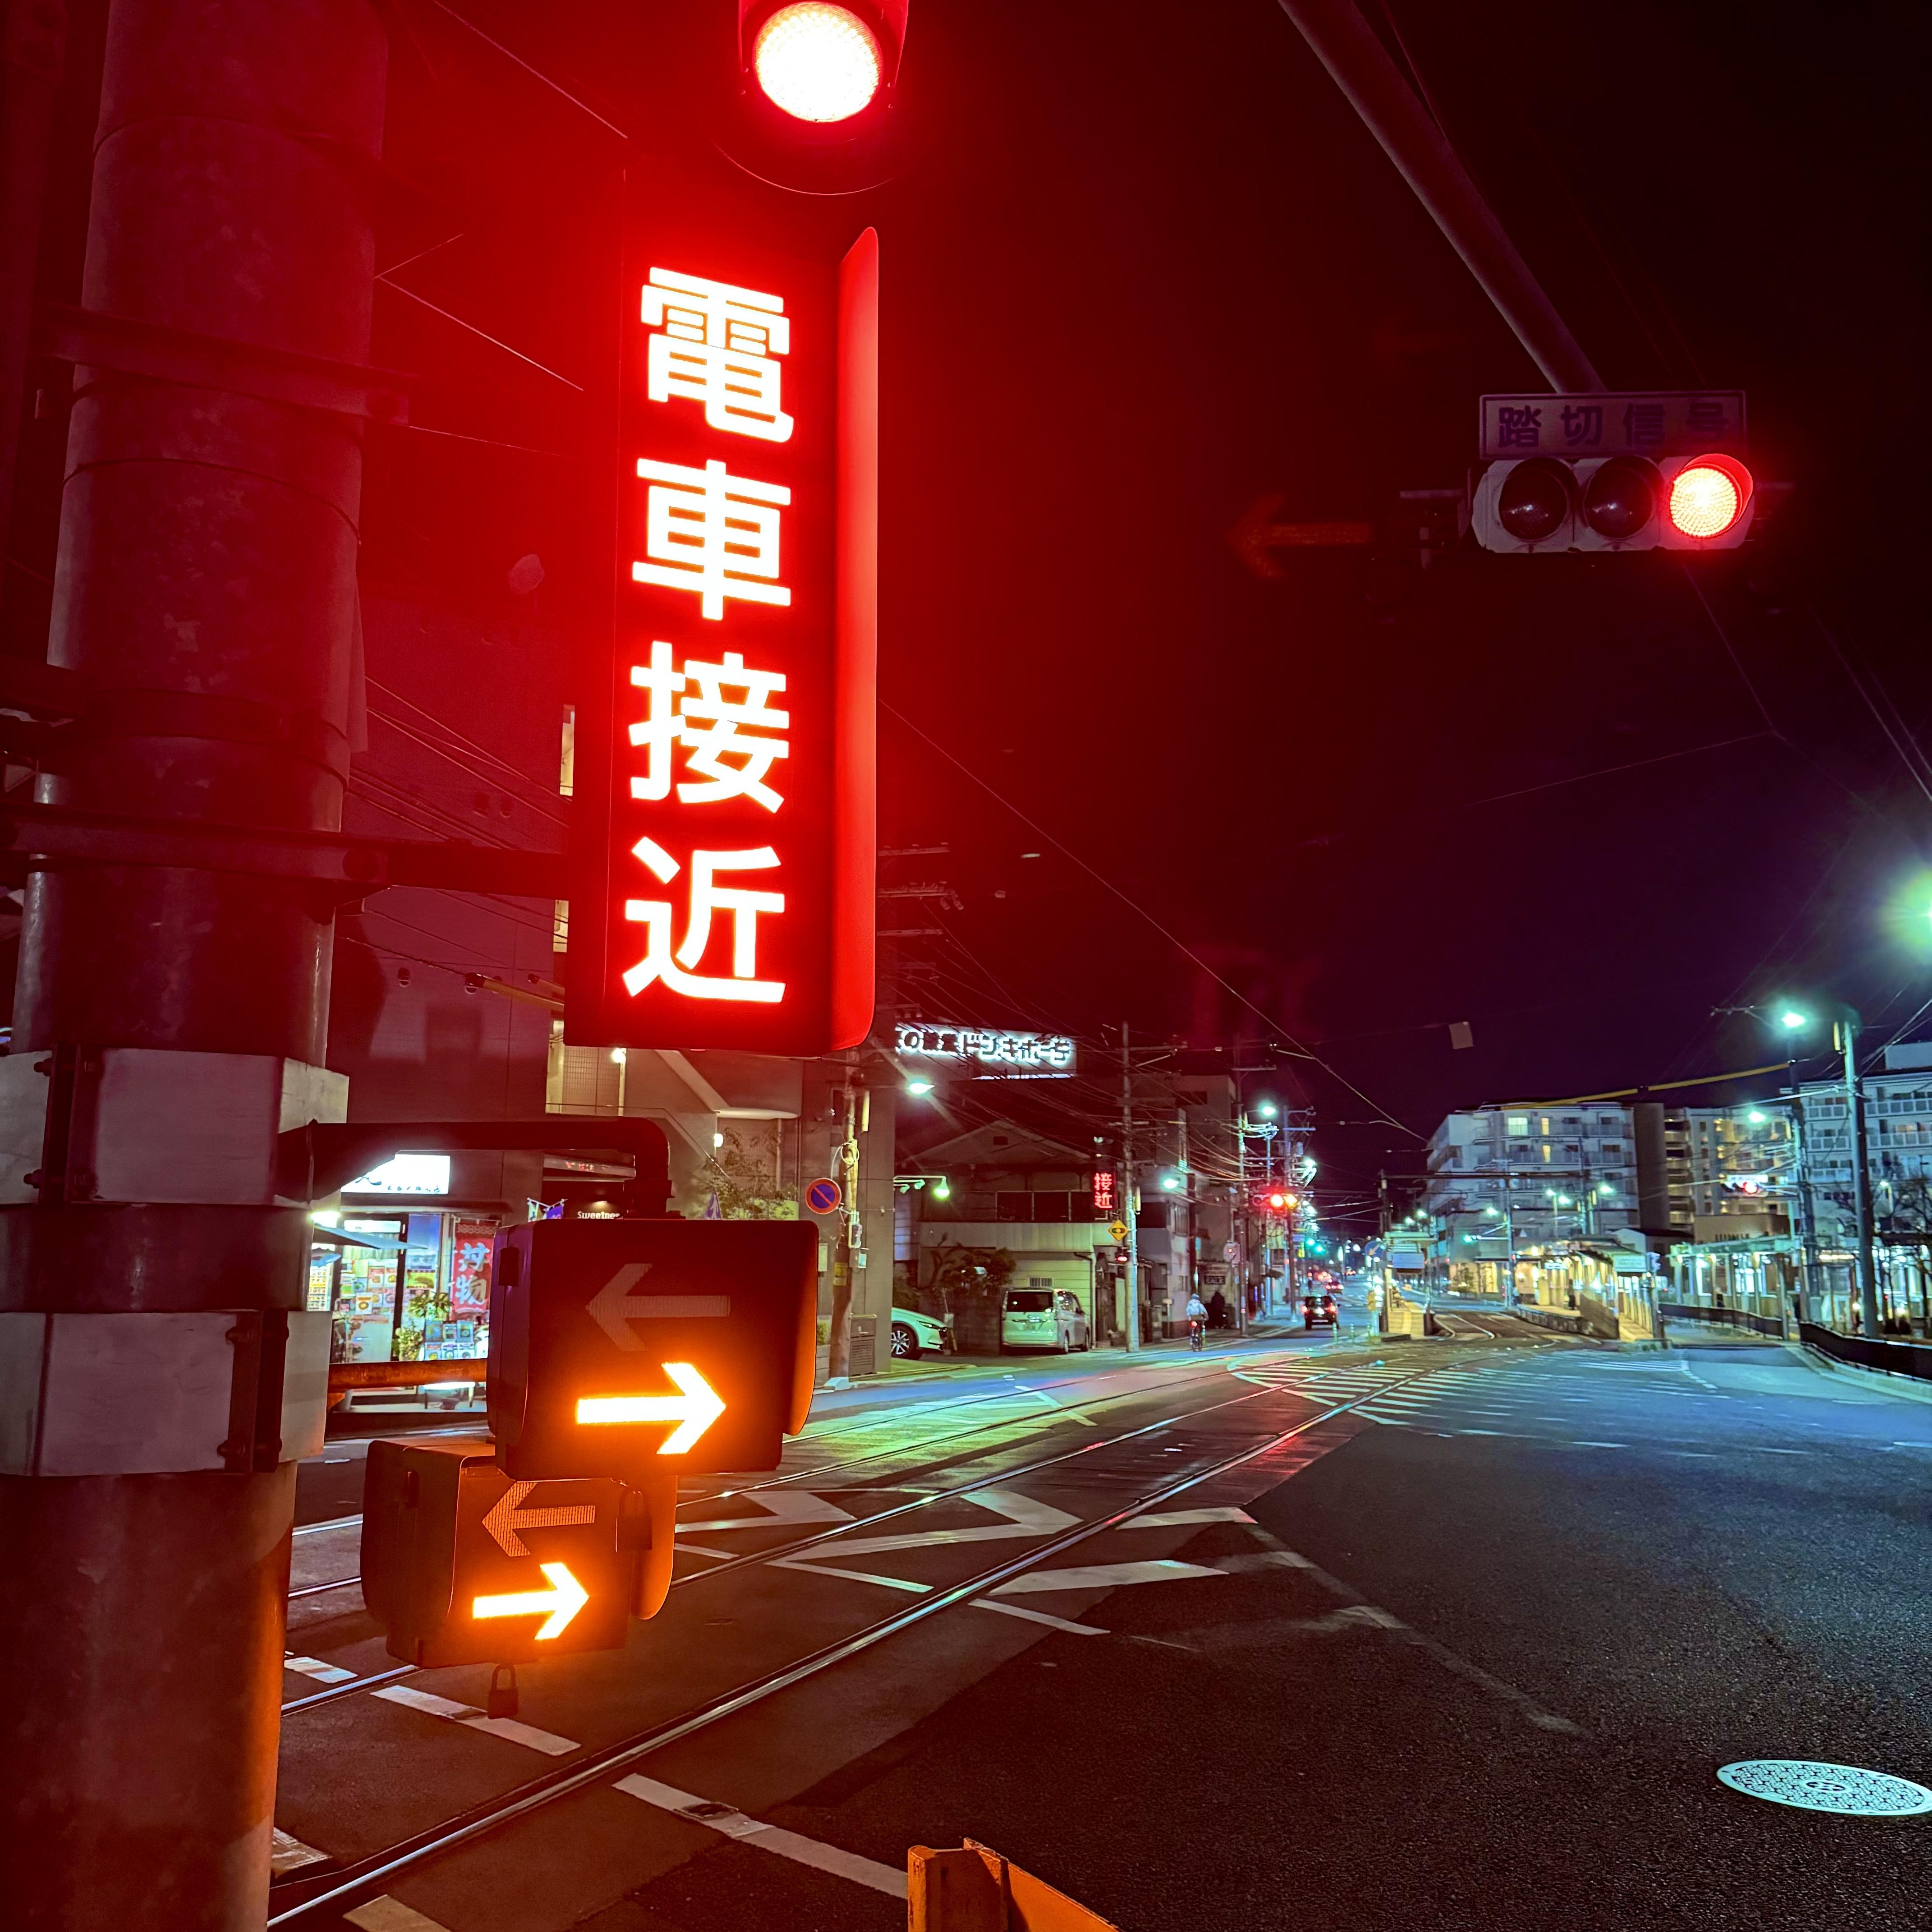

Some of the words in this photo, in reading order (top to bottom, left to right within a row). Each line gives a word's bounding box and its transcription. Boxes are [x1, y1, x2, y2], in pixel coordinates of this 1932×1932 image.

[1499, 402, 1729, 448] 踏切信号
[622, 266, 795, 1005] 電車接近
[1094, 1172, 1113, 1208] 接近
